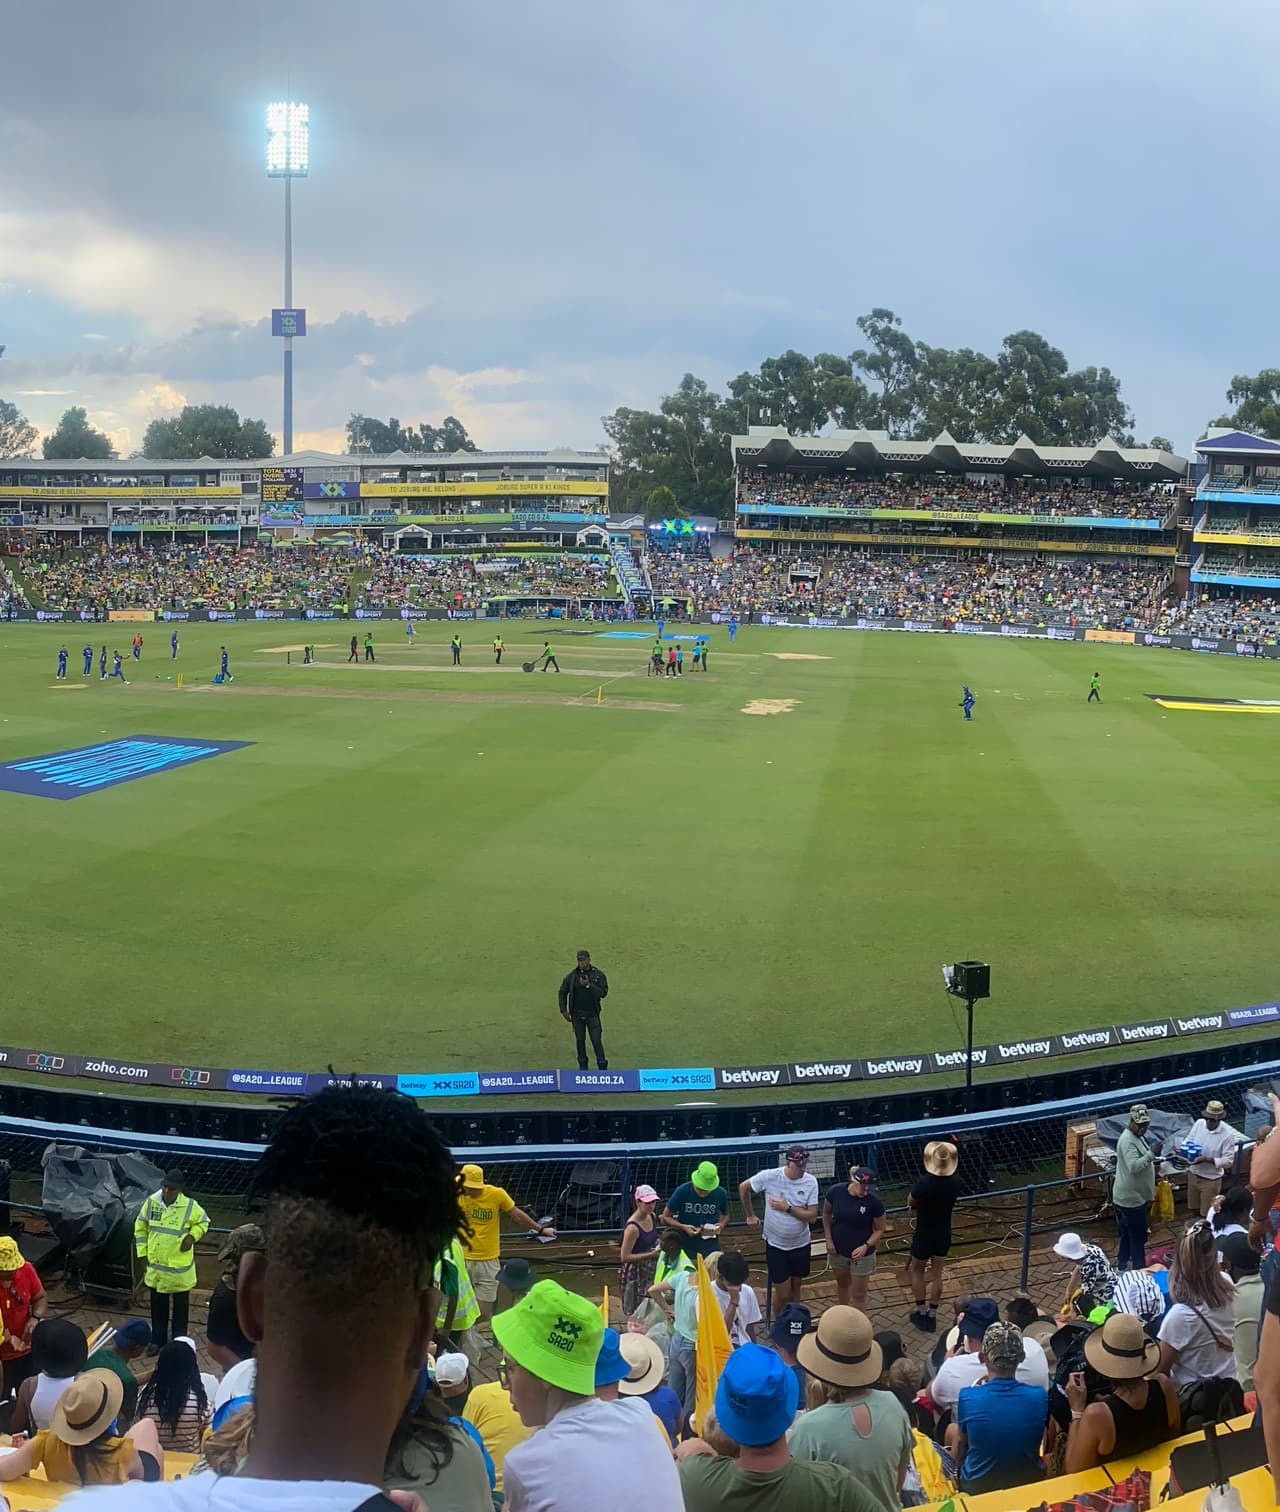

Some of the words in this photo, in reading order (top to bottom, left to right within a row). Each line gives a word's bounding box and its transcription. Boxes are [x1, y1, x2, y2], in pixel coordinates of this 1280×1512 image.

[1177, 1015, 1223, 1032] betway
[1062, 1030, 1111, 1048] betway
[1121, 1023, 1168, 1041] betway
[999, 1040, 1051, 1058] betway
[85, 1060, 149, 1079] zoho.com
[795, 1062, 852, 1078] betway
[867, 1058, 923, 1075] betway
[232, 1073, 303, 1087] @SA20_LEAGUE
[401, 1082, 428, 1091] betway
[453, 1080, 474, 1090] SA20
[482, 1075, 554, 1087] @SA20_LEAGUE
[575, 1075, 624, 1085] SA20.CO.ZA
[643, 1076, 669, 1086] betway
[690, 1075, 712, 1084] SA20
[722, 1070, 780, 1086] betway
[685, 1202, 717, 1216] BOSS
[547, 1331, 575, 1353] SA20
